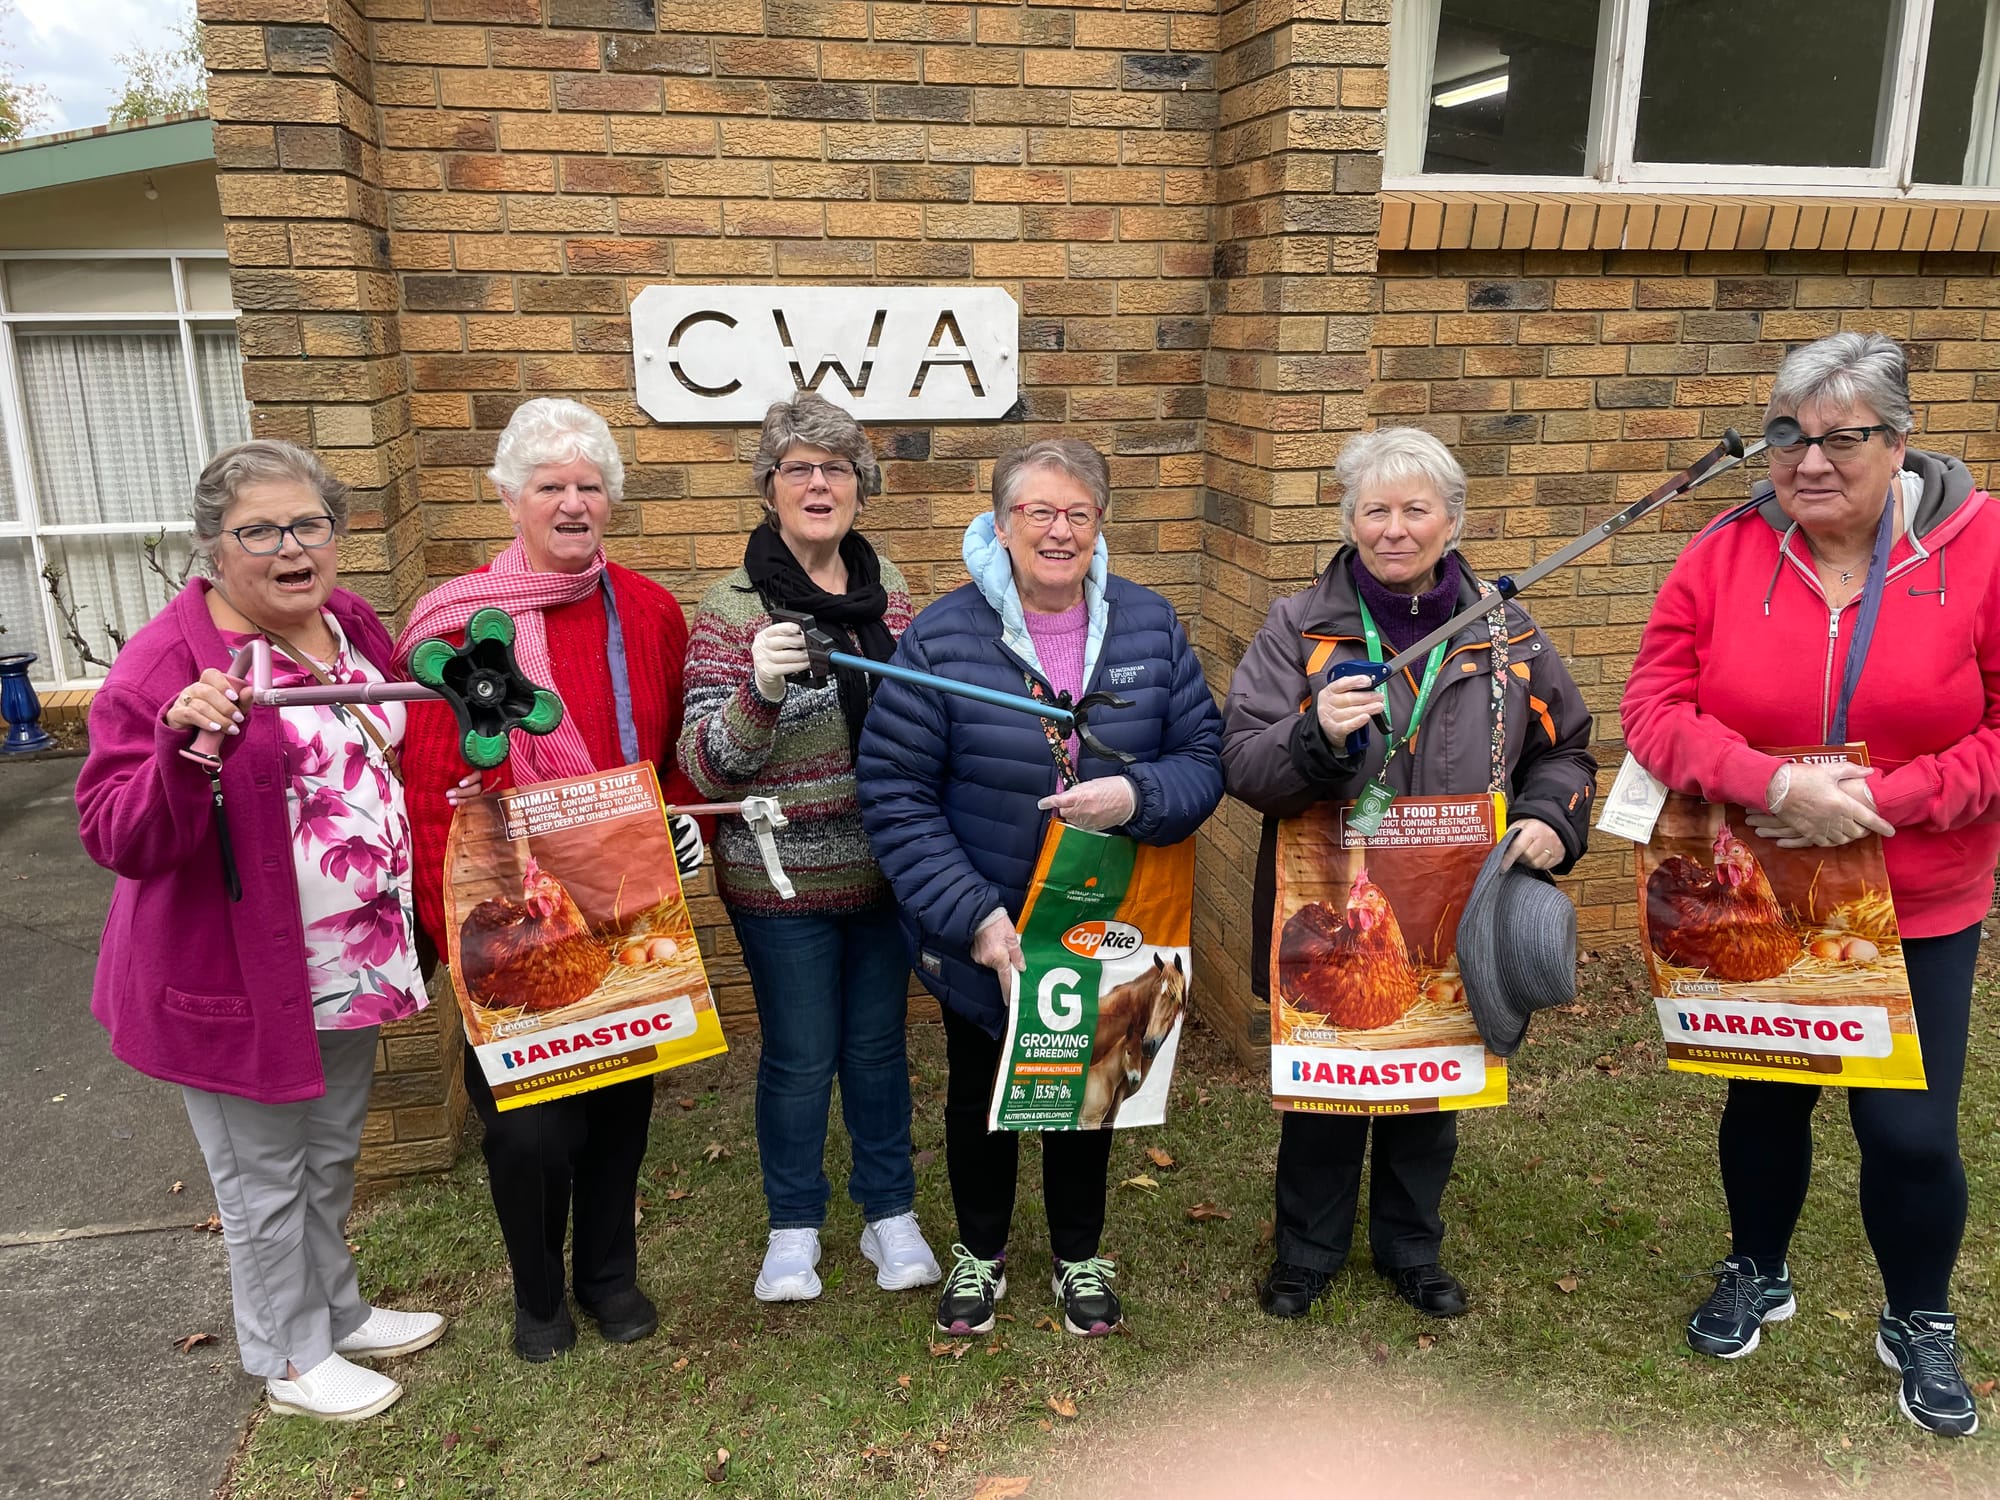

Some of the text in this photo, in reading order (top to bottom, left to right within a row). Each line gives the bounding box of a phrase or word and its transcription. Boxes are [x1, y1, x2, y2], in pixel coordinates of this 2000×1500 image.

[667, 309, 987, 398] CWA
[509, 773, 638, 811] ANIMAL FOOD STUFF
[510, 784, 644, 820] THIS PRODUCT CONTAINS RESTRICTED
[1403, 806, 1437, 818] FOOD
[1441, 804, 1478, 817] STUFF
[508, 818, 529, 829] ANIMAL
[567, 807, 578, 816] DO
[579, 803, 594, 813] NOT
[595, 799, 613, 810] FEED
[614, 796, 624, 805] TO
[554, 817, 574, 828] DEER
[574, 814, 586, 824] OR
[586, 809, 610, 821] OTHER
[1400, 818, 1437, 828] CONTAINS
[1438, 816, 1482, 826] RESTRICTED
[1390, 836, 1410, 845] DEER
[1410, 836, 1422, 845] OR
[1422, 835, 1446, 844] OTHER
[1405, 828, 1416, 836] DO
[1417, 827, 1432, 836] NOT
[1432, 827, 1451, 835] FEED
[1451, 826, 1461, 834] TO
[1037, 966, 1083, 1032] G
[1677, 1012, 1865, 1042] BARASTOC
[502, 1012, 673, 1070] BARASTOC
[1019, 1033, 1089, 1049] GROWING
[1025, 1048, 1079, 1059] & BREEDING
[1687, 1048, 1810, 1067] ESSENTIAL FEEDS
[514, 1056, 630, 1092] ESSENTIAL FEEDS
[1292, 1060, 1462, 1086] BARASTOC
[1010, 1085, 1026, 1100] 16%
[1003, 1112, 1032, 1120] NUTRITION
[1036, 1112, 1074, 1120] DEVELOPMENT
[1293, 1100, 1411, 1114] ESSENTIAL FEEDS
